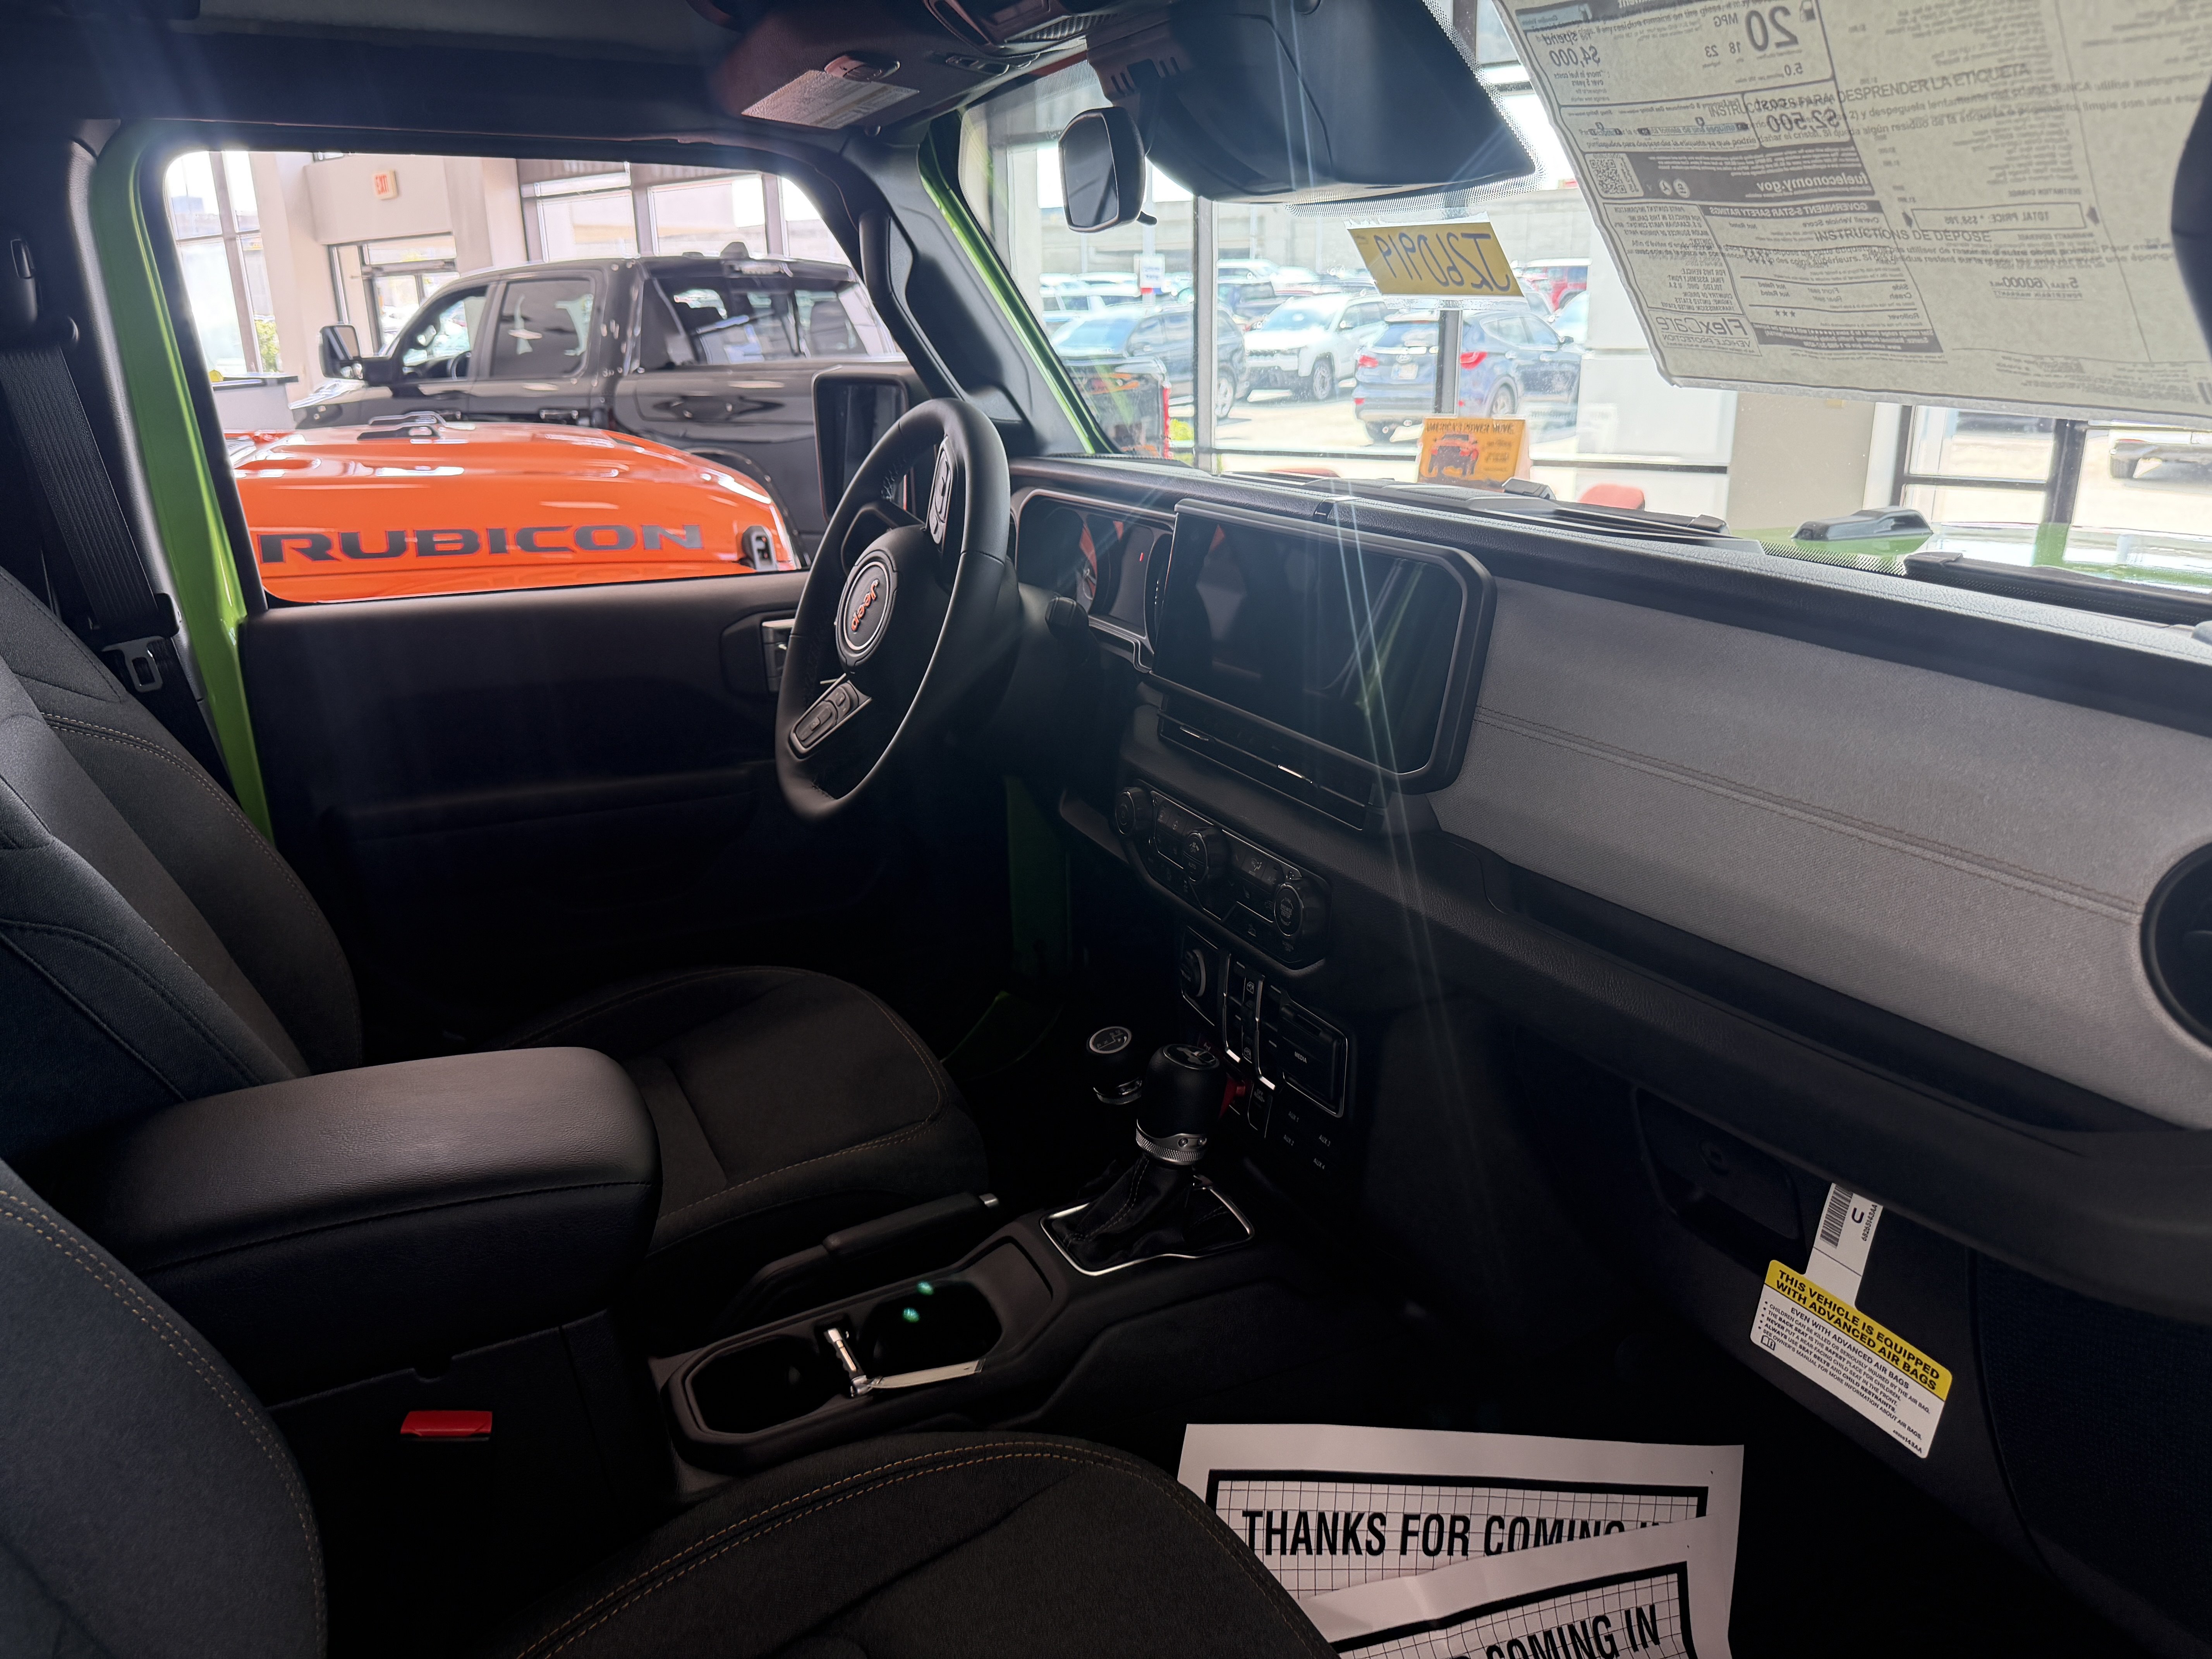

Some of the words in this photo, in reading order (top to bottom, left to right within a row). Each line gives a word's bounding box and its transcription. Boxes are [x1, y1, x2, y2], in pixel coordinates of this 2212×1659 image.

[1839, 79, 1929, 104] DESPRENDER
[1930, 75, 1951, 92] LA
[375, 174, 389, 195] EXIT
[1814, 228, 1910, 242] INSTRUCTIONS
[1913, 228, 1931, 240] DE
[258, 524, 703, 563] RUBICON
[851, 579, 879, 632] Jeep
[1295, 1051, 1307, 1063] MEDIA
[1288, 1111, 1296, 1121] AUX
[1319, 1135, 1328, 1145] AUX
[1313, 1158, 1322, 1167] AUX
[1851, 1207, 1865, 1224] U
[1767, 1309, 1778, 1319] THE
[1778, 1316, 1793, 1329] BACK
[1794, 1326, 1808, 1338] SEAT
[1814, 1338, 1824, 1349] THE
[1824, 1346, 1846, 1363] SAFEST
[1845, 1359, 1863, 1374] PLACE
[1862, 1371, 1874, 1382] FOR
[1775, 1279, 1807, 1306] WITH
[1808, 1300, 1877, 1350] ADVANCED
[1877, 1344, 1901, 1366] AIR
[1901, 1361, 1937, 1391] BAGS
[1777, 1269, 1807, 1294] THIS
[1807, 1287, 1860, 1328] VEHICLE
[1861, 1321, 1875, 1337] IS
[1875, 1331, 1941, 1381] EQUIPPED
[1790, 1306, 1810, 1324] EVEN
[1811, 1319, 1831, 1337] WITH
[1831, 1333, 1873, 1365] ADVANCED
[1873, 1360, 1888, 1375] AIR
[1887, 1370, 1910, 1389] BAGS
[1764, 1321, 1788, 1341] ALWAYS
[1788, 1336, 1798, 1347] USE
[1798, 1343, 1813, 1357] SEAT
[1813, 1353, 1830, 1368] BELTS
[1830, 1364, 1842, 1376] AND
[1841, 1372, 1860, 1388] CHILD
[1766, 1316, 1784, 1331] NEVER
[1784, 1328, 1795, 1338] PUT
[1832, 1358, 1849, 1373] CHILD
[1848, 1369, 1862, 1381] SEAT
[1862, 1378, 1869, 1386] IN
[1869, 1382, 1879, 1393] THE
[1769, 1303, 1795, 1323] CHILDREN
[1794, 1319, 1806, 1330] CAN
[1814, 1331, 1831, 1346] KILLED
[1831, 1343, 1839, 1351] OR
[1839, 1348, 1868, 1370] SERIOUSLY
[1867, 1366, 1890, 1385] INJURED
[1889, 1381, 1897, 1390] BY
[1896, 1386, 1908, 1398] THE
[1907, 1395, 1918, 1405] AIR
[1763, 1328, 1772, 1338] SEE
[1796, 1349, 1817, 1367] MANUAL
[1817, 1363, 1829, 1374] FOR
[1828, 1370, 1844, 1384] MORE
[1843, 1381, 1880, 1409] INFORMATION
[1879, 1405, 1898, 1422] ABOUT
[1896, 1418, 1907, 1429] AIR
[1242, 1510, 1387, 1556] THANKS
[1400, 1513, 1470, 1557] FOR
[1624, 1603, 1661, 1653] IN
